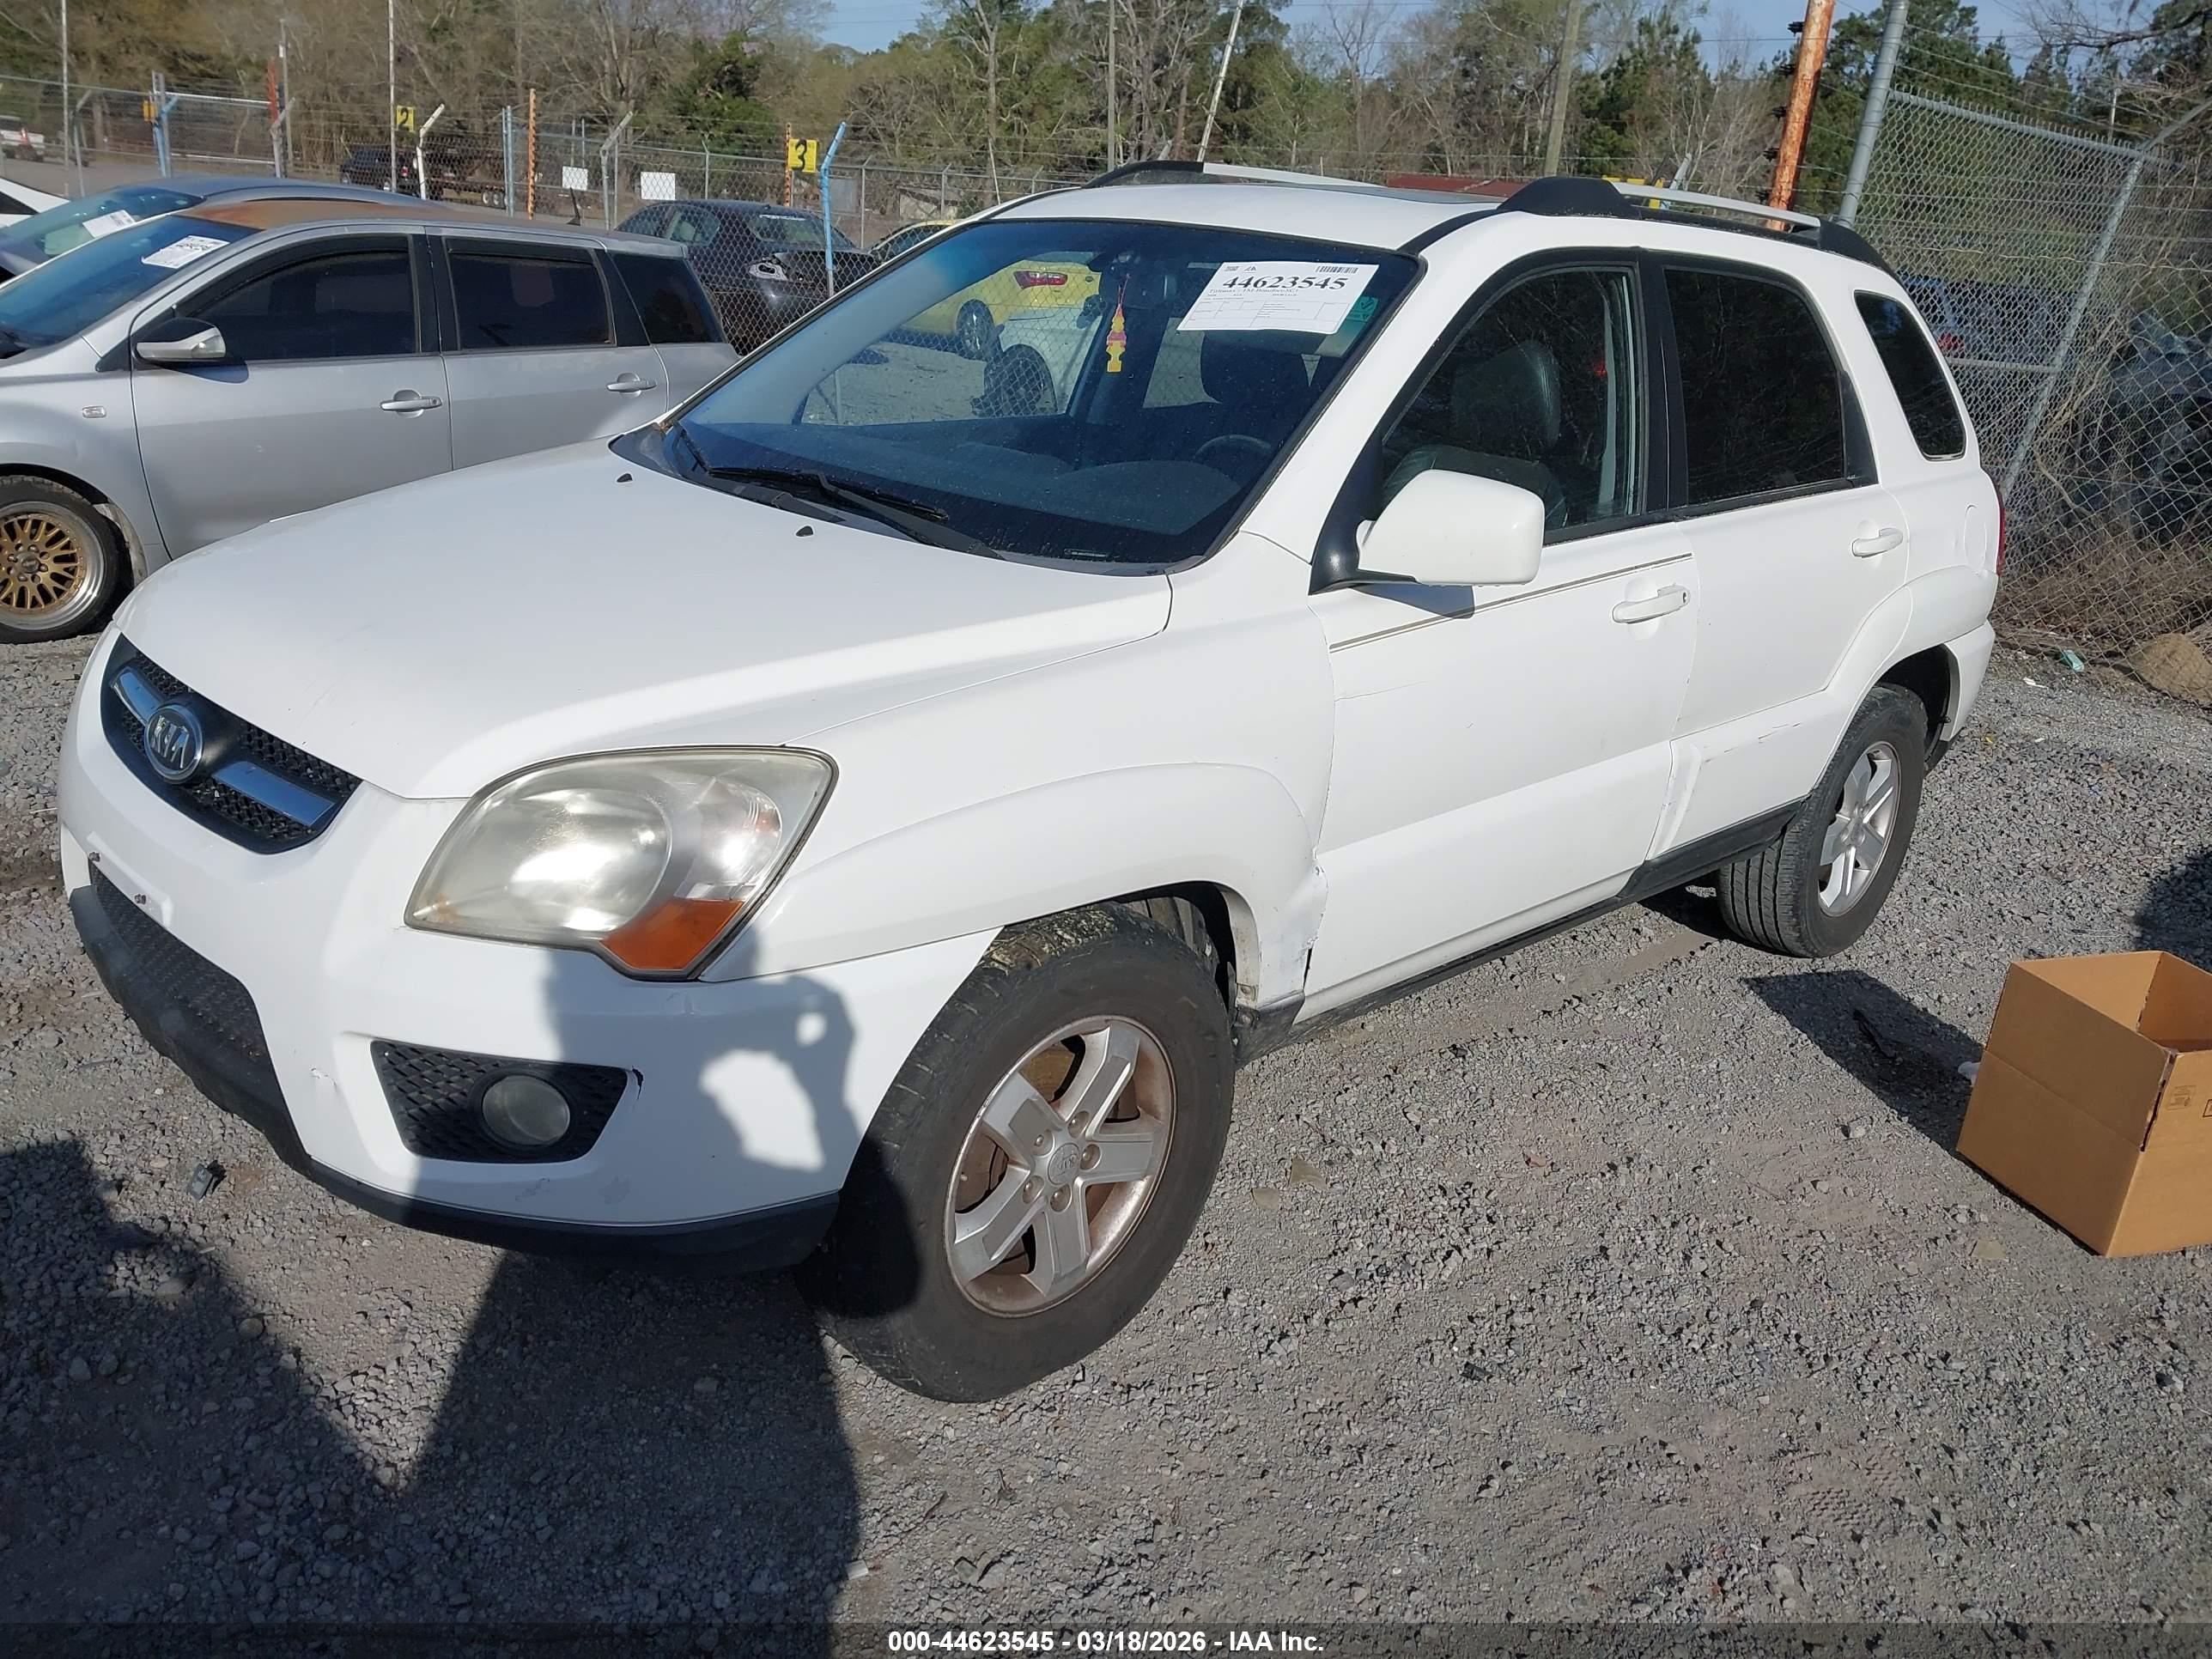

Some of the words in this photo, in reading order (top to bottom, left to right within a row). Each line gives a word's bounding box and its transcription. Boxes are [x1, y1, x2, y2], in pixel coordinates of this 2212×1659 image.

[398, 107, 410, 131] 2
[792, 137, 807, 173] 3
[1223, 276, 1348, 290] 44623545
[150, 714, 190, 769] KIA
